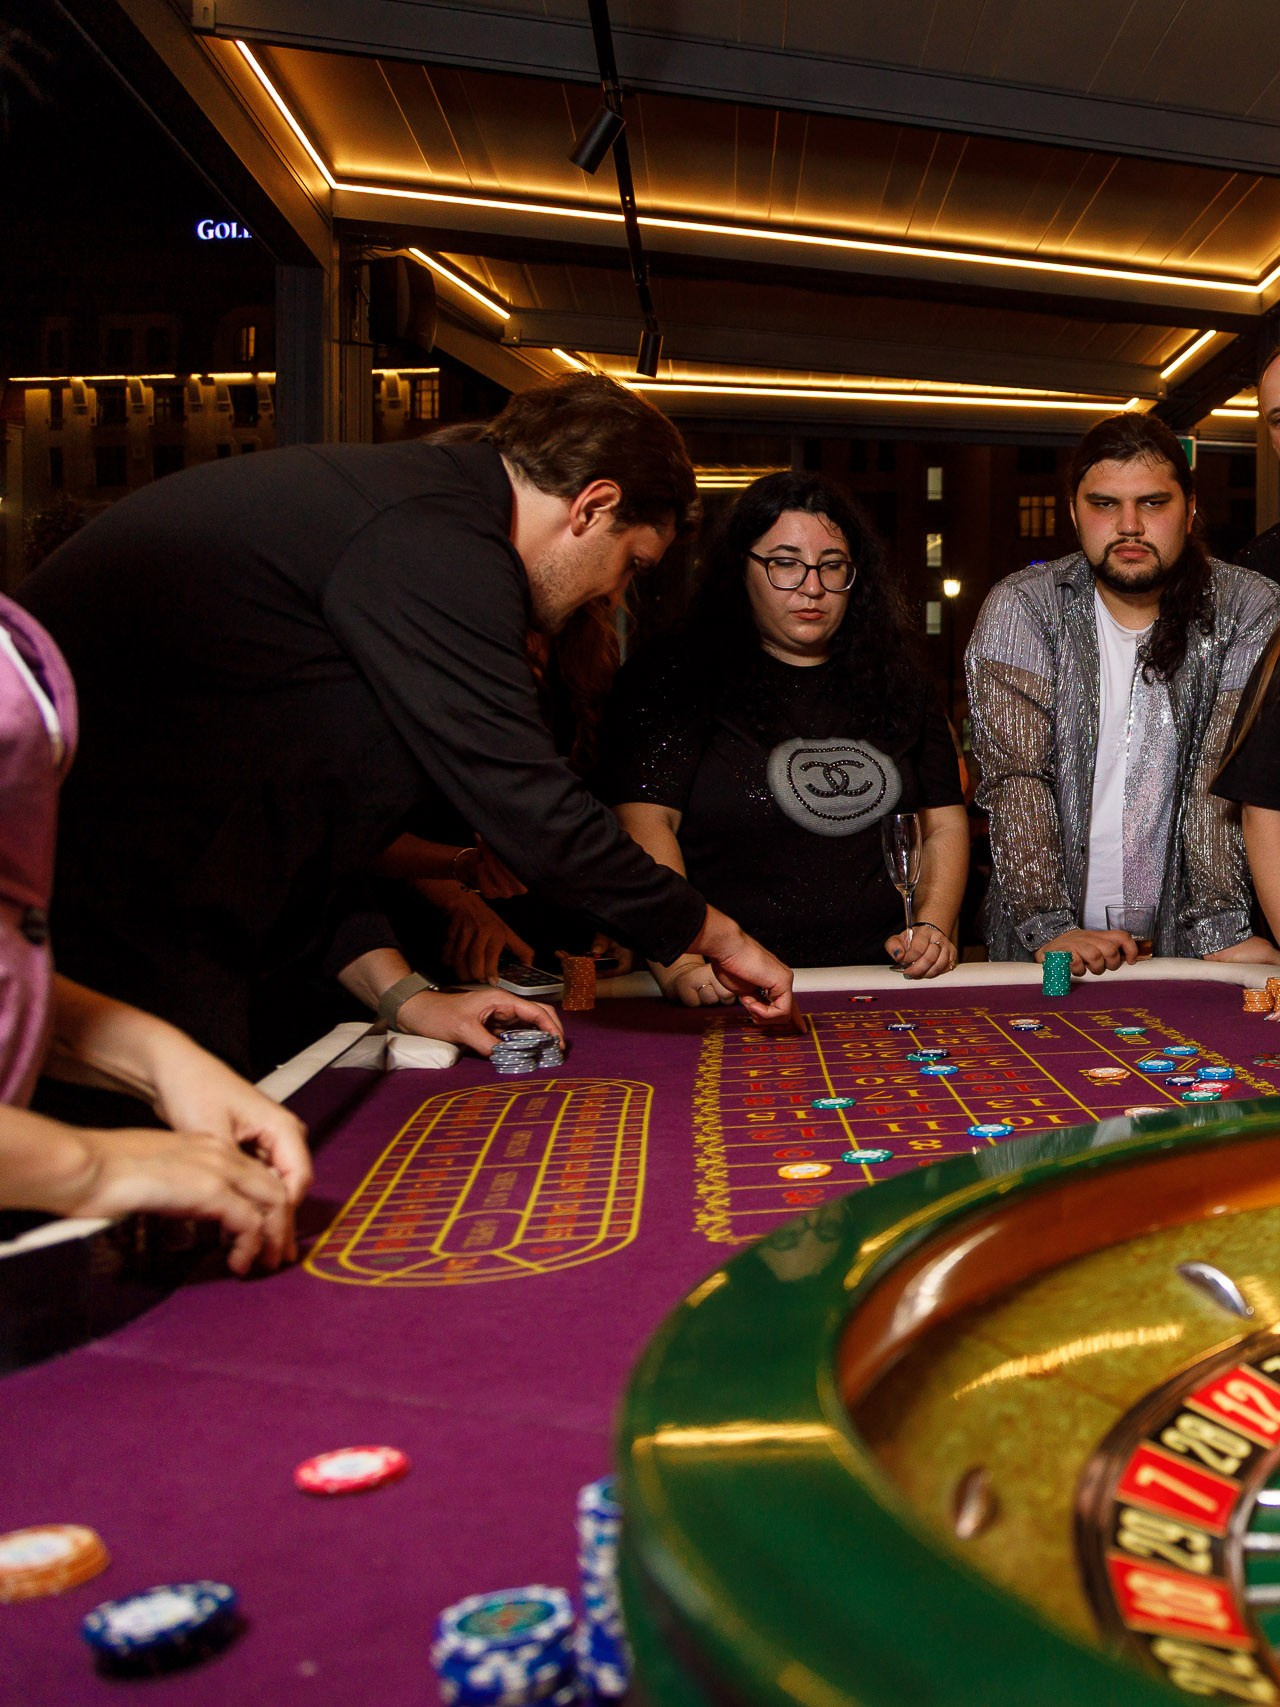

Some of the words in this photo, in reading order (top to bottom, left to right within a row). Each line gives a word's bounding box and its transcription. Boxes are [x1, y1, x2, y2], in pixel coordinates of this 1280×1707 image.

[741, 1067, 806, 1077] 24
[741, 1080, 807, 1090] 21
[855, 1075, 918, 1085] 20
[864, 1089, 927, 1099] 17
[866, 1103, 938, 1115] 14
[986, 1098, 1048, 1108] 13
[746, 1110, 813, 1122] 15
[1001, 1114, 1070, 1126] 10
[880, 1120, 947, 1132] 11
[747, 1126, 823, 1140] 12
[908, 1139, 943, 1150] 8
[773, 1146, 814, 1159] 9
[1160, 1412, 1255, 1474] 28
[1137, 1465, 1218, 1513] 7
[1118, 1510, 1212, 1574] 29
